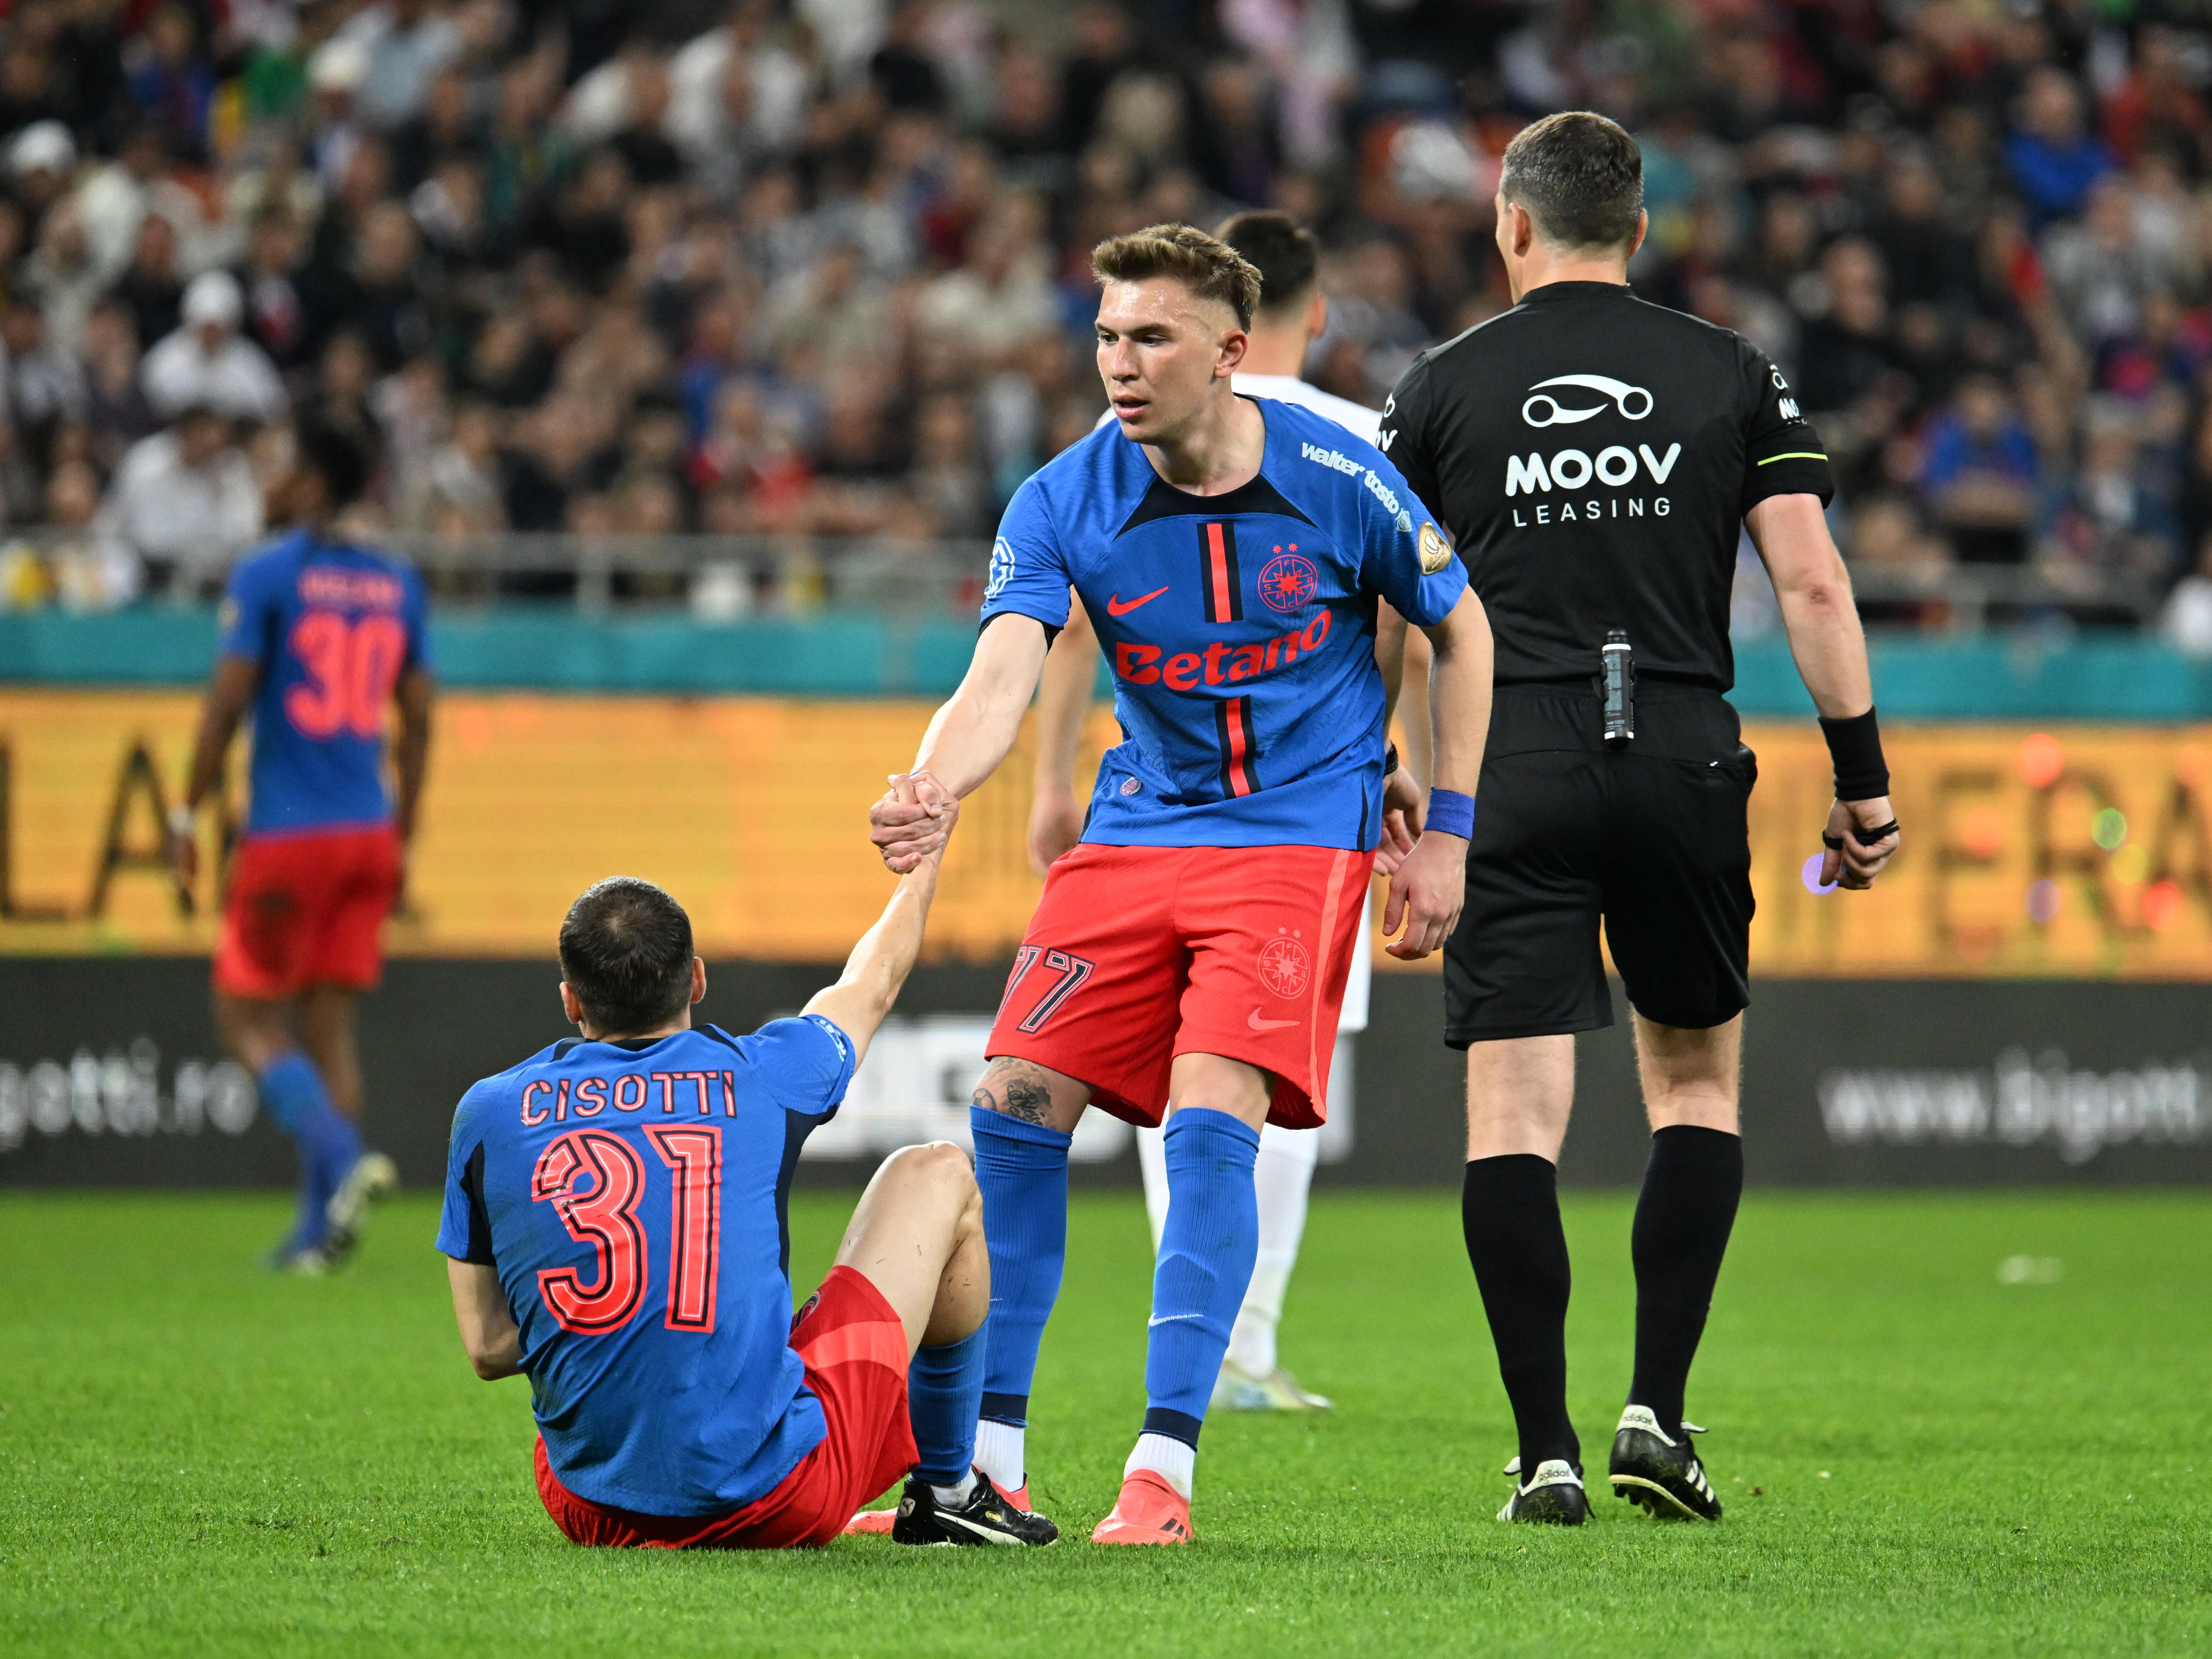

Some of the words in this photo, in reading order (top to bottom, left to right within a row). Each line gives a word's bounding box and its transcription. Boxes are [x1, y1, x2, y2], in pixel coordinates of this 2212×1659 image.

[1302, 442, 1365, 476] walter
[1364, 470, 1399, 514] tosto
[1506, 443, 1681, 496] MOOV
[1513, 498, 1670, 527] LEASING
[285, 610, 406, 740] 30
[1116, 610, 1331, 691] Betano
[992, 944, 1095, 1034] 77
[521, 1070, 736, 1127] CISOTTI
[532, 1124, 721, 1335] 31
